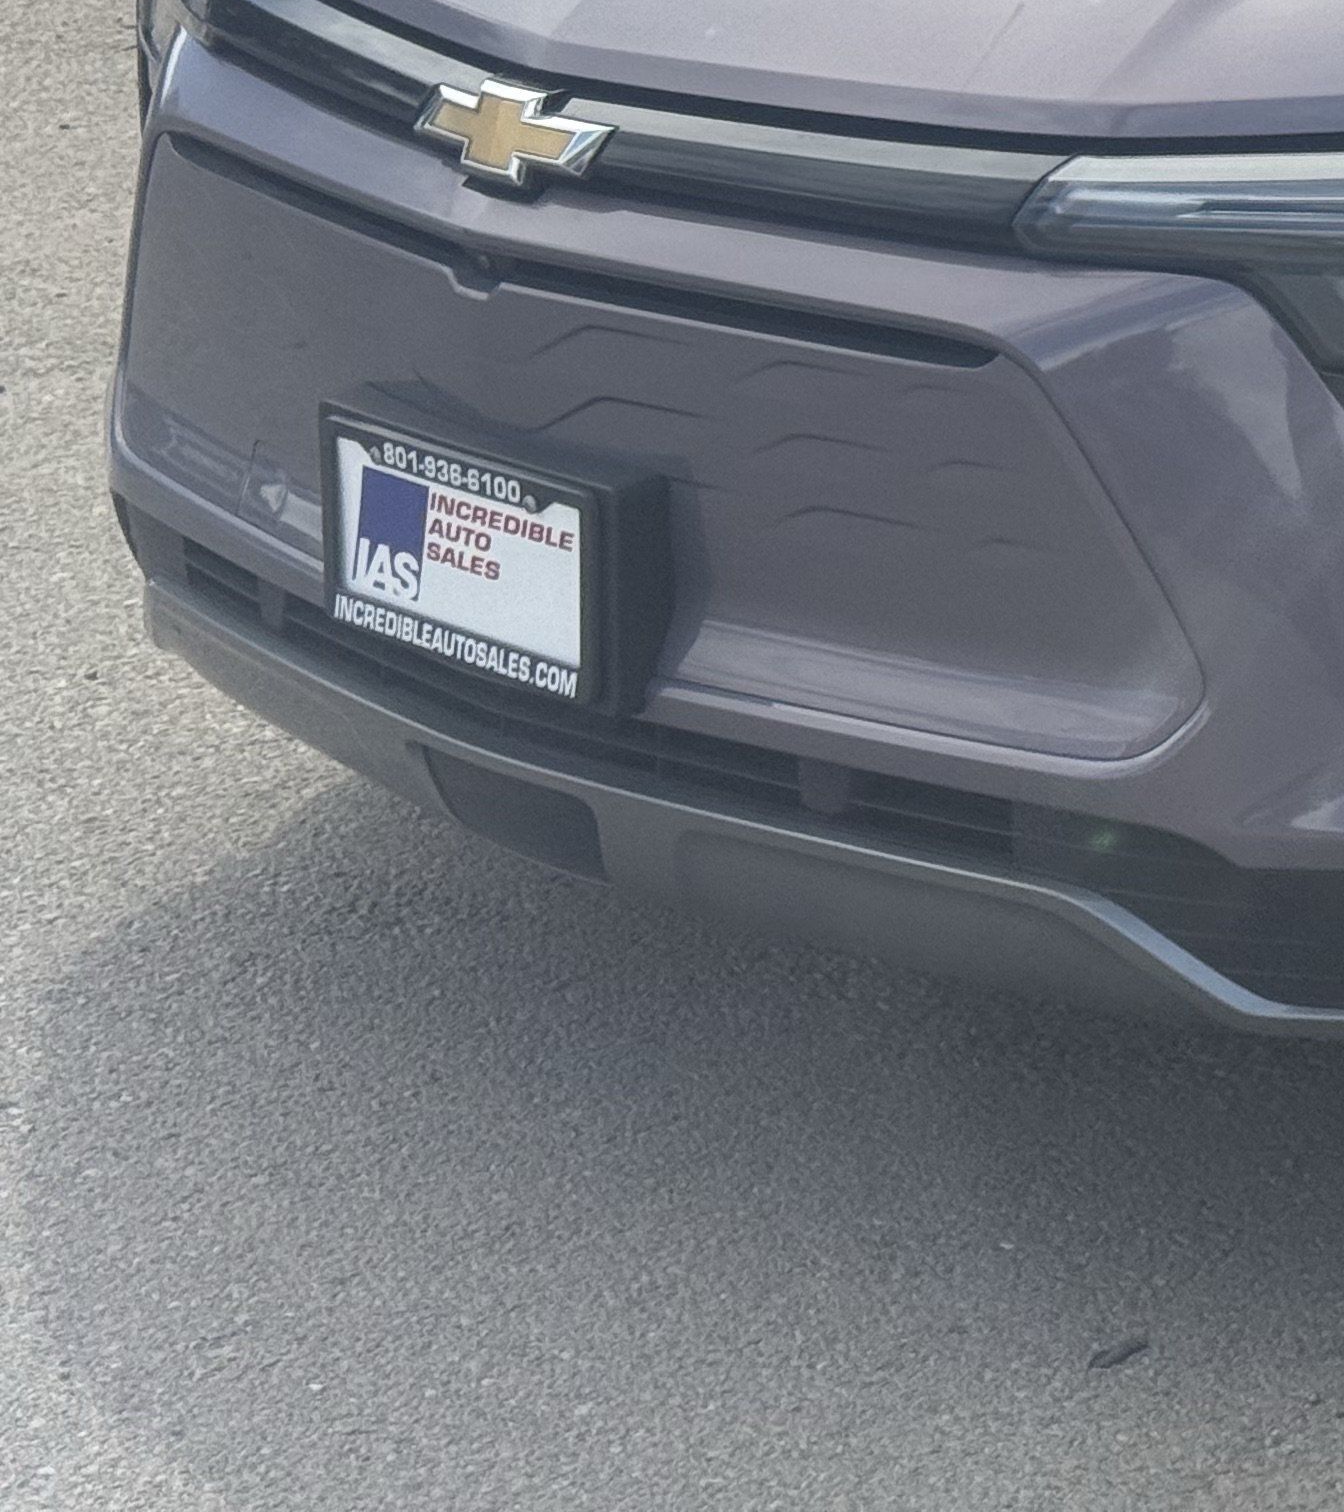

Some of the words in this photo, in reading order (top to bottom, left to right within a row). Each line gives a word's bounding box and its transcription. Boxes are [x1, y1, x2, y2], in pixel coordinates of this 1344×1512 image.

[382, 441, 522, 504] 801-936-6100
[428, 518, 493, 553] AUTO
[429, 492, 575, 551] INCREDIBLE
[354, 537, 420, 601] IAS
[426, 541, 501, 581] SALES
[333, 593, 579, 699] INCREDIBLEAUTOSALES.COM
